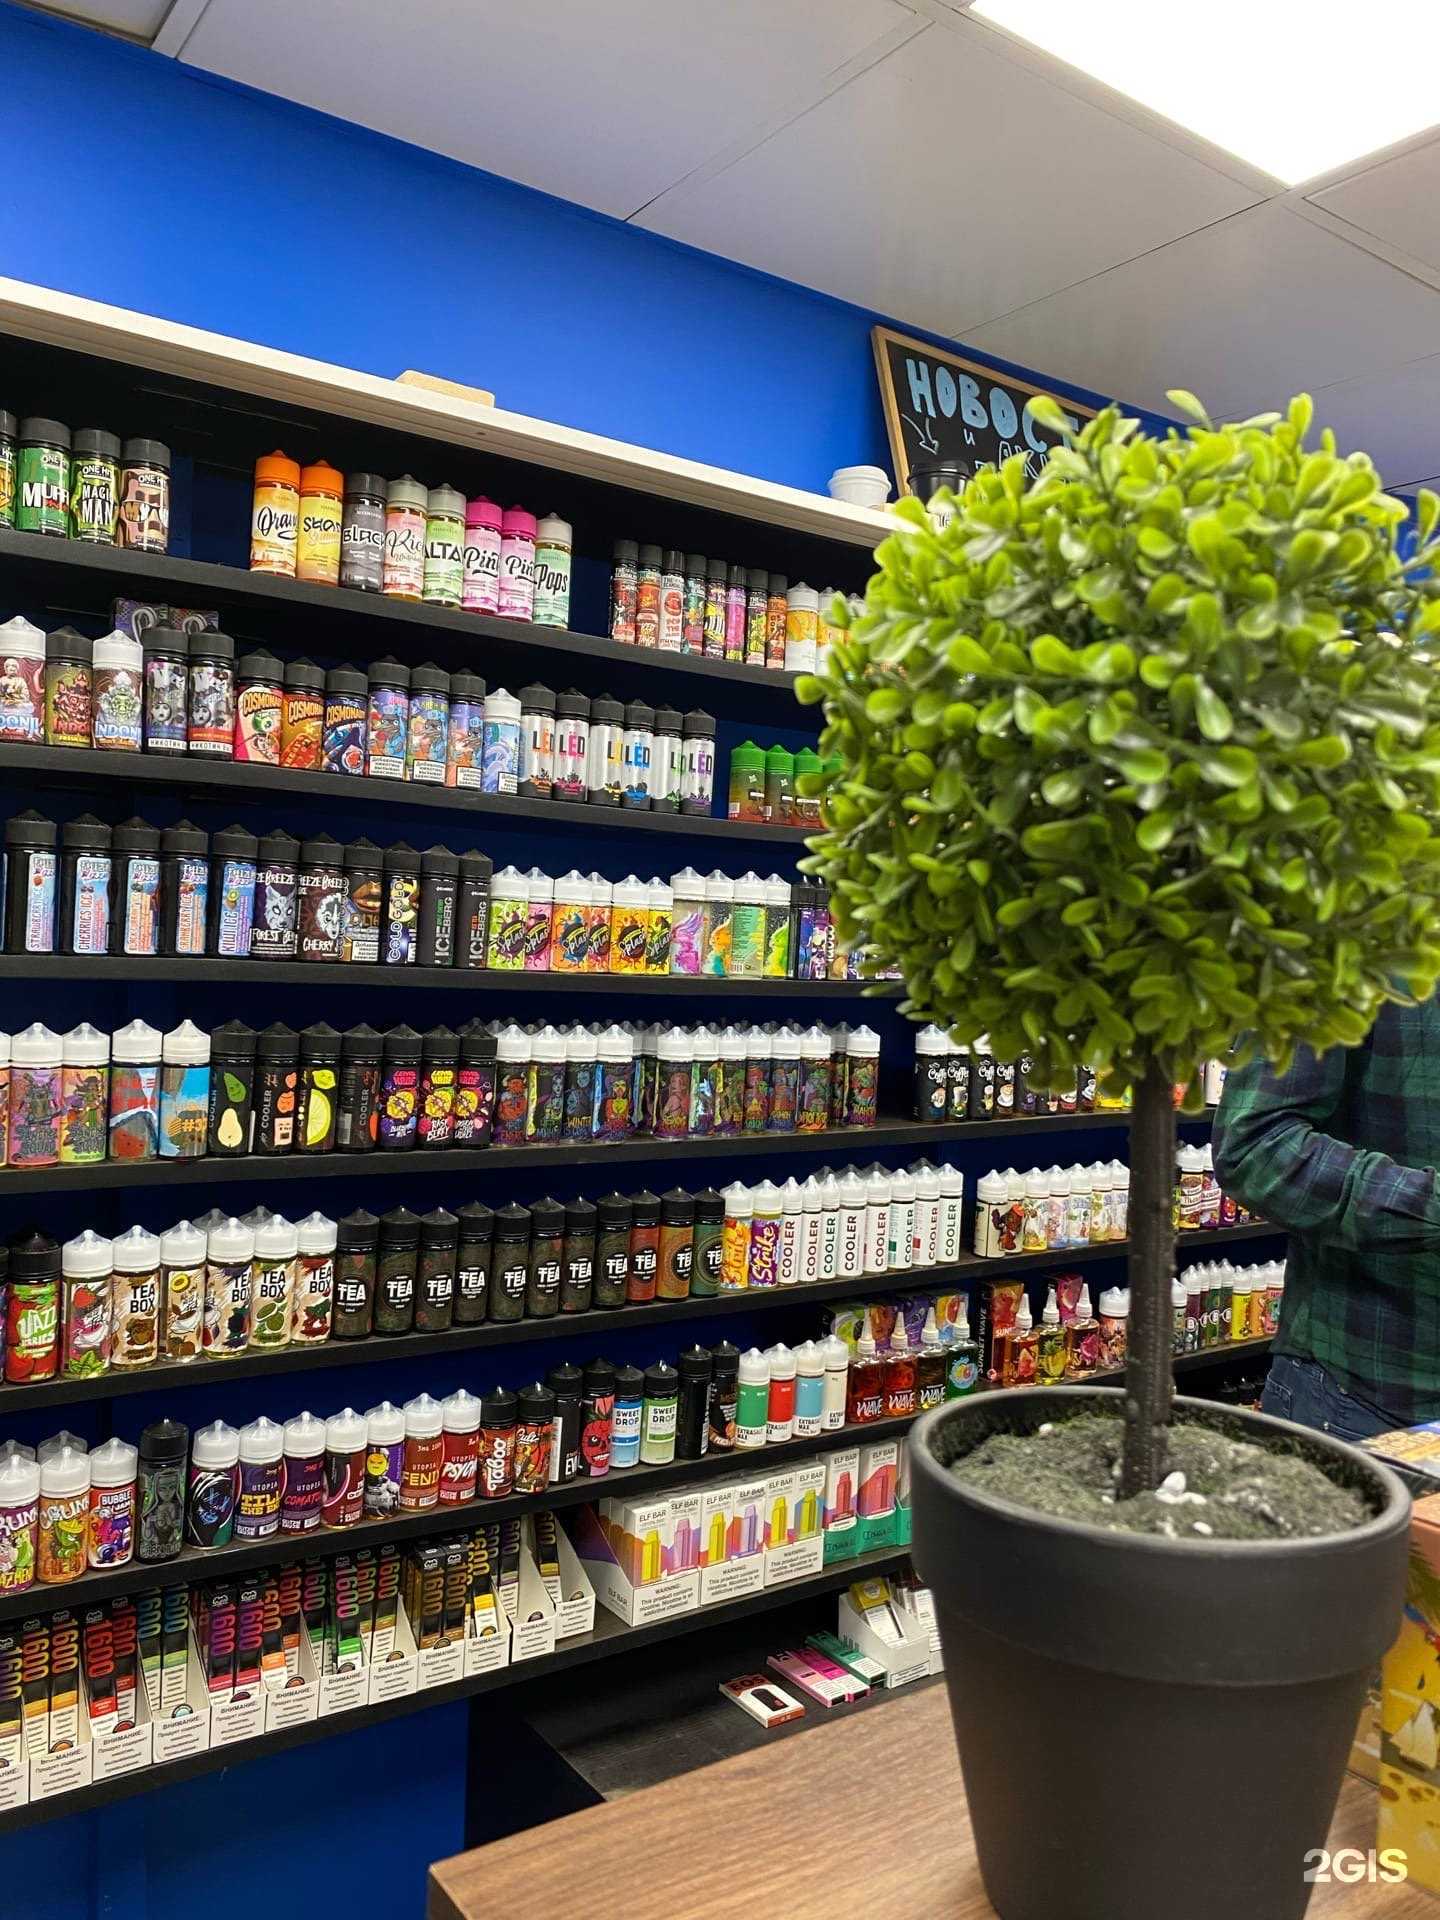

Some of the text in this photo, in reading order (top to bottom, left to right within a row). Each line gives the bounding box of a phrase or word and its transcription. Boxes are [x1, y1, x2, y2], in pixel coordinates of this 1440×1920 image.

[906, 358, 1080, 455] НОВОС
[82, 465, 100, 475] ONE
[535, 563, 568, 596] Pops
[560, 733, 584, 758] LED
[626, 742, 650, 768] LED
[690, 751, 712, 775] LED
[265, 870, 296, 885] BREEZE
[303, 937, 334, 952] CHERRY
[262, 1090, 272, 1128] COOLER
[360, 1089, 369, 1126] COOLER
[875, 1211, 887, 1267] COOLER
[905, 1208, 914, 1263] COOLER
[929, 1207, 938, 1261] COOLER
[945, 1204, 957, 1257] COOLER
[782, 1220, 795, 1278] COOLER
[806, 1219, 819, 1276] COOLER
[823, 1217, 836, 1274] COOLER
[844, 1215, 857, 1271] COOLER
[569, 1261, 592, 1278] TEA
[606, 1257, 628, 1274] TEA
[635, 1253, 656, 1270] TEA
[262, 1270, 286, 1285] TEA
[312, 1265, 332, 1280] TEA
[459, 1271, 485, 1288] TEA
[504, 1269, 526, 1287] TEA
[538, 1266, 560, 1283] TEA
[132, 1284, 155, 1299] TEA
[261, 1284, 286, 1298] BOX
[338, 1282, 366, 1301] TEA
[387, 1279, 413, 1298] TEA
[427, 1278, 452, 1297] TEA
[130, 1298, 155, 1313] BOX
[616, 1408, 640, 1418] SWEET
[652, 1415, 675, 1424] DROP
[653, 1407, 675, 1415] SWEET
[615, 1417, 640, 1426] DROP
[834, 1453, 857, 1464] ELF BAR
[872, 1448, 895, 1459] ELF BAR
[768, 1477, 793, 1489] ELF BAR
[799, 1471, 823, 1482] ELF BAR
[252, 1482, 278, 1491] UTOPIA
[739, 1486, 764, 1498] ELF BAR
[101, 1491, 131, 1506] BUBBLE
[671, 1498, 698, 1511] ELF BAR
[706, 1493, 732, 1505] ELF BAR
[639, 1510, 666, 1523] ELF BAR
